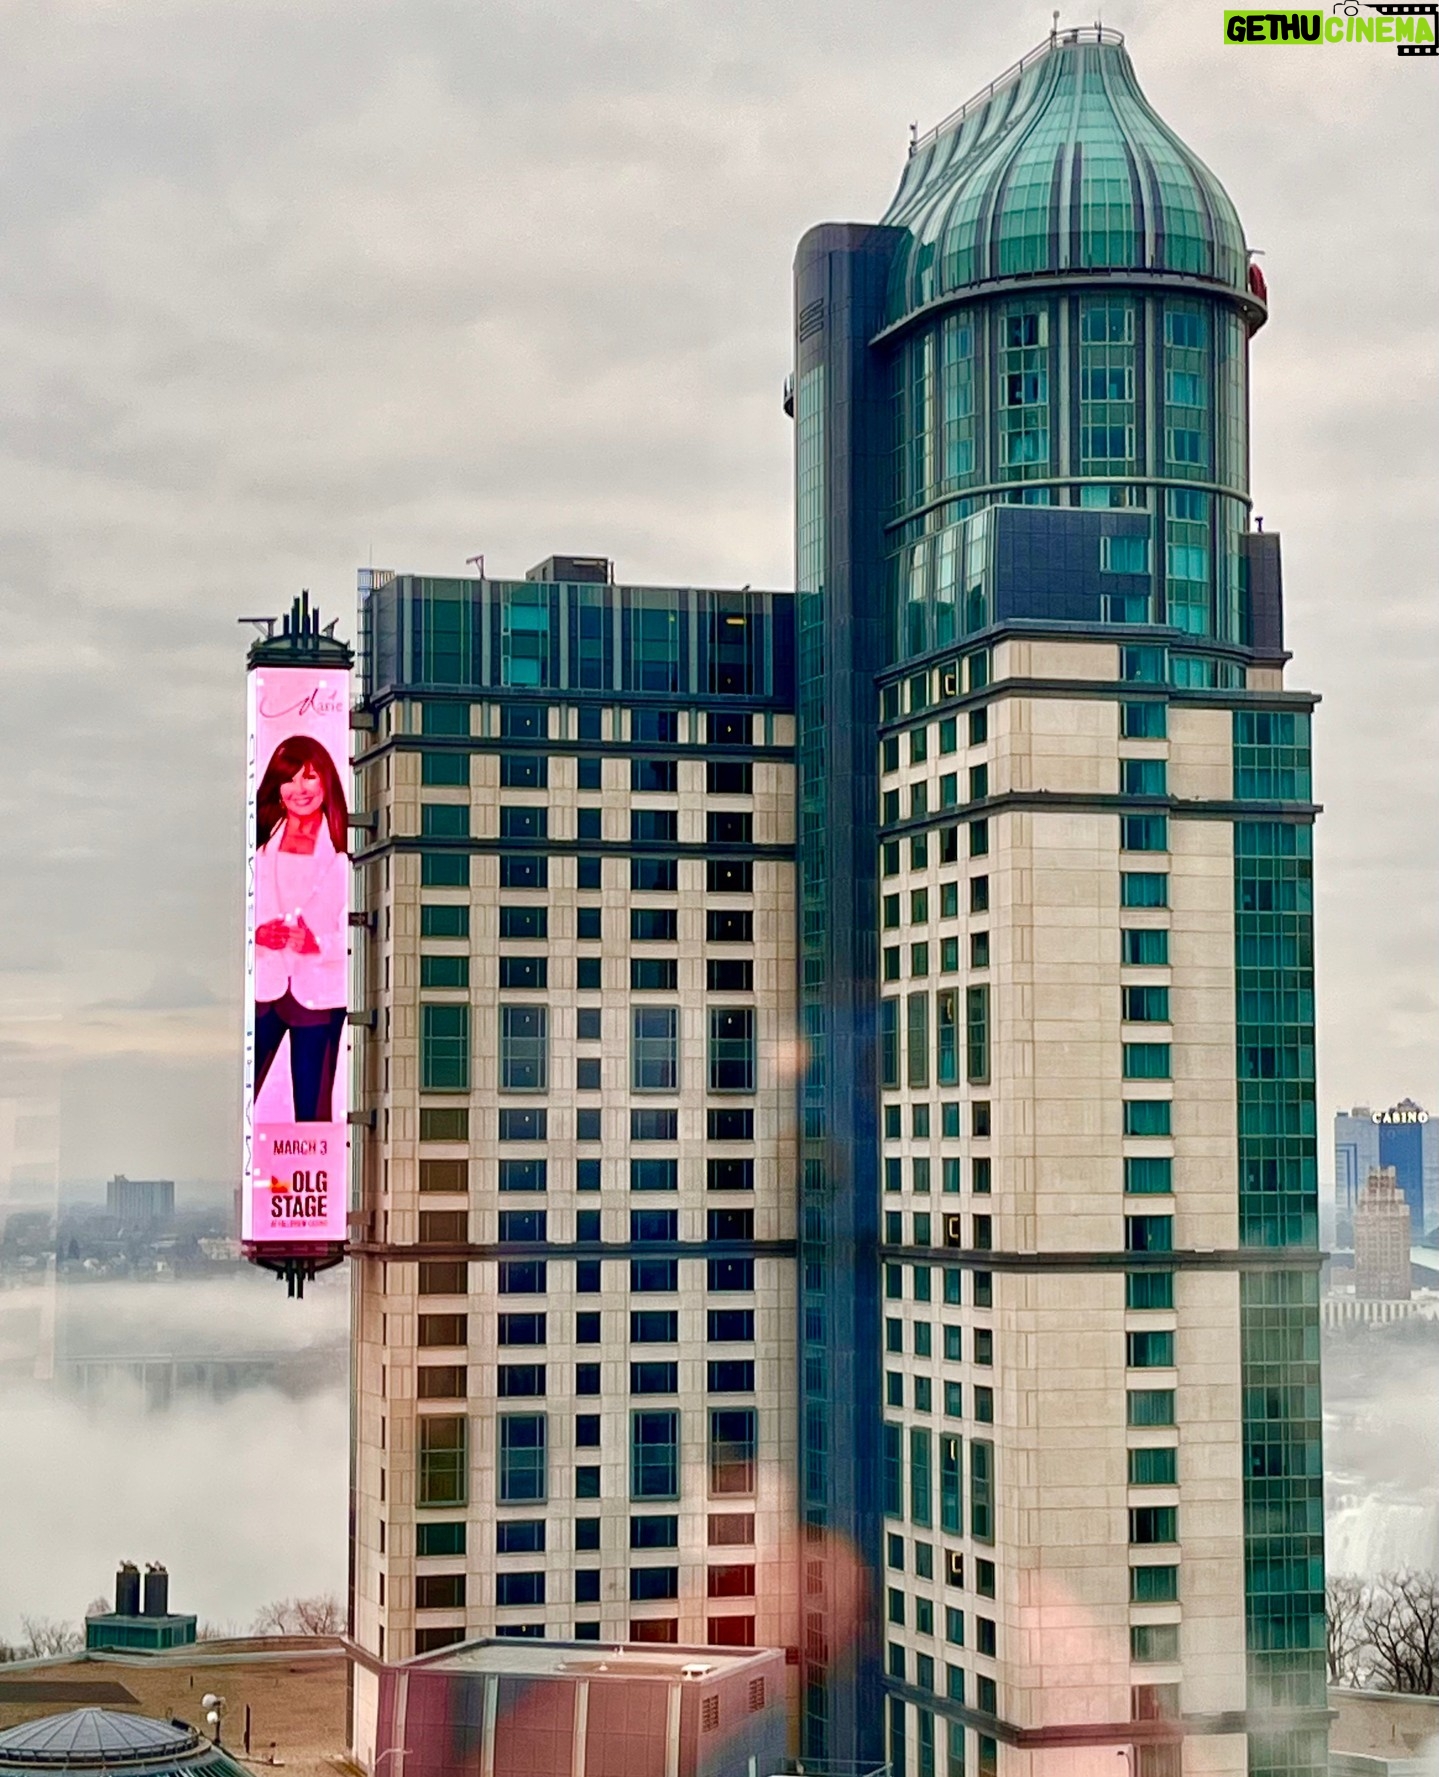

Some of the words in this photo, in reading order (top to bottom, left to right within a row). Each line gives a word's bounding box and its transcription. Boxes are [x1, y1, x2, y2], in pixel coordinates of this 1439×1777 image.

[259, 688, 343, 718] Marie
[1372, 1111, 1429, 1124] CASINO
[273, 1140, 316, 1155] MARCH
[320, 1140, 327, 1155] 3
[292, 1170, 328, 1193] OLG
[271, 1195, 328, 1218] STAGE
